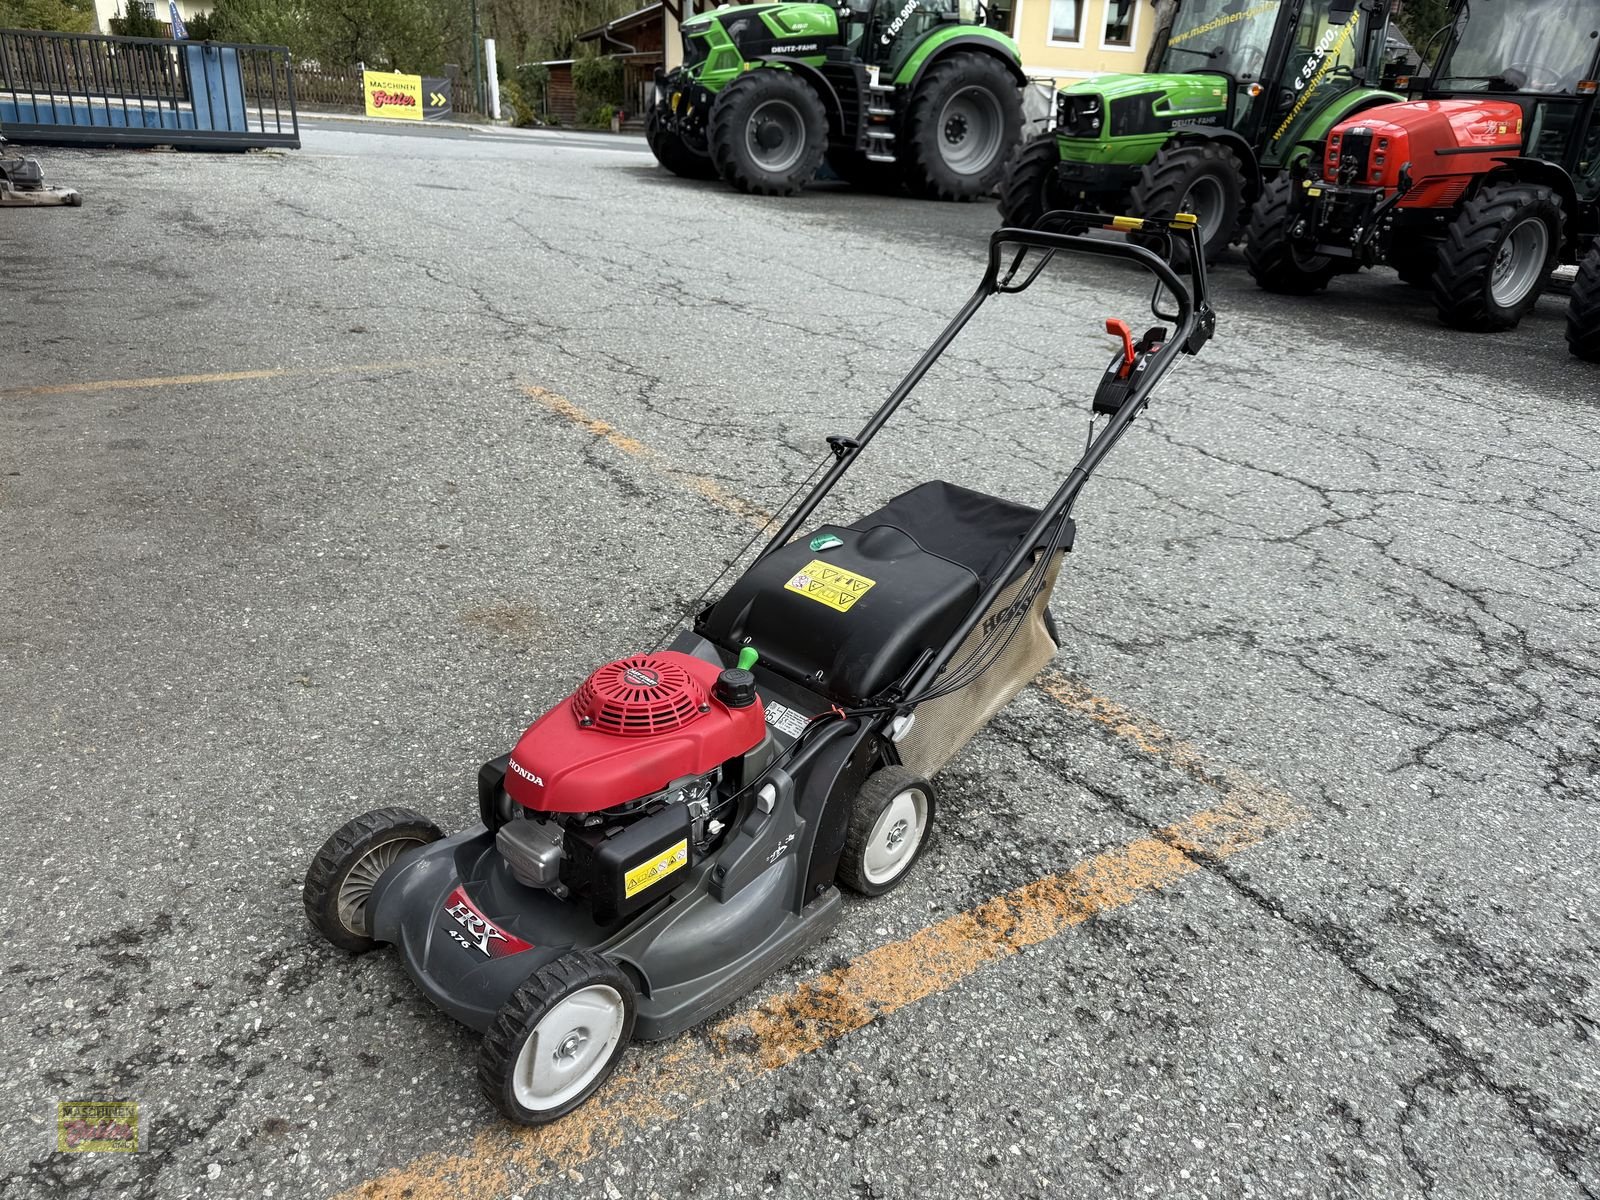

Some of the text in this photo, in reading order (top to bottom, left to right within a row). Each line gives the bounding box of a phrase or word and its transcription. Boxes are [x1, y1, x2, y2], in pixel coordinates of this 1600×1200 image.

[771, 44, 817, 53] DEUTZ-FAHR
[369, 81, 416, 91] MASCHINEN
[1294, 76, 1305, 90] €
[508, 757, 545, 788] HONDA
[444, 900, 508, 958] HRX
[448, 930, 471, 949] 476
